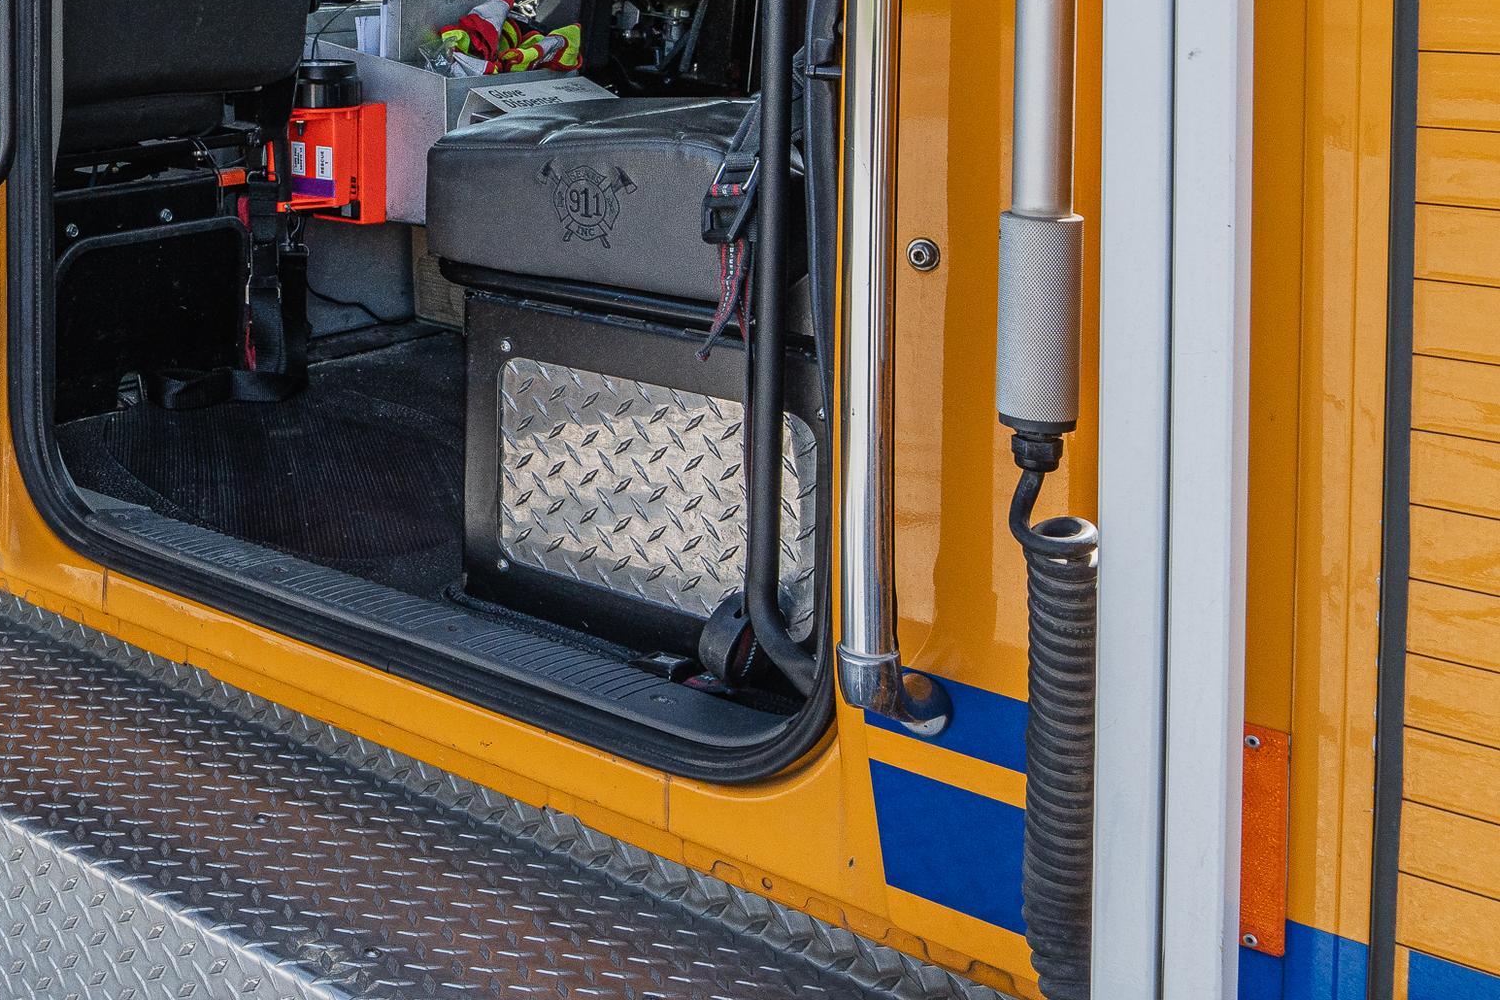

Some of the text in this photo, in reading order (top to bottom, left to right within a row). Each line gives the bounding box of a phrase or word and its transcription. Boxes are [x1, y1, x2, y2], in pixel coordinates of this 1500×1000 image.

[488, 89, 526, 99] Glove
[502, 95, 564, 109] Dispenser
[569, 187, 602, 218] 911
